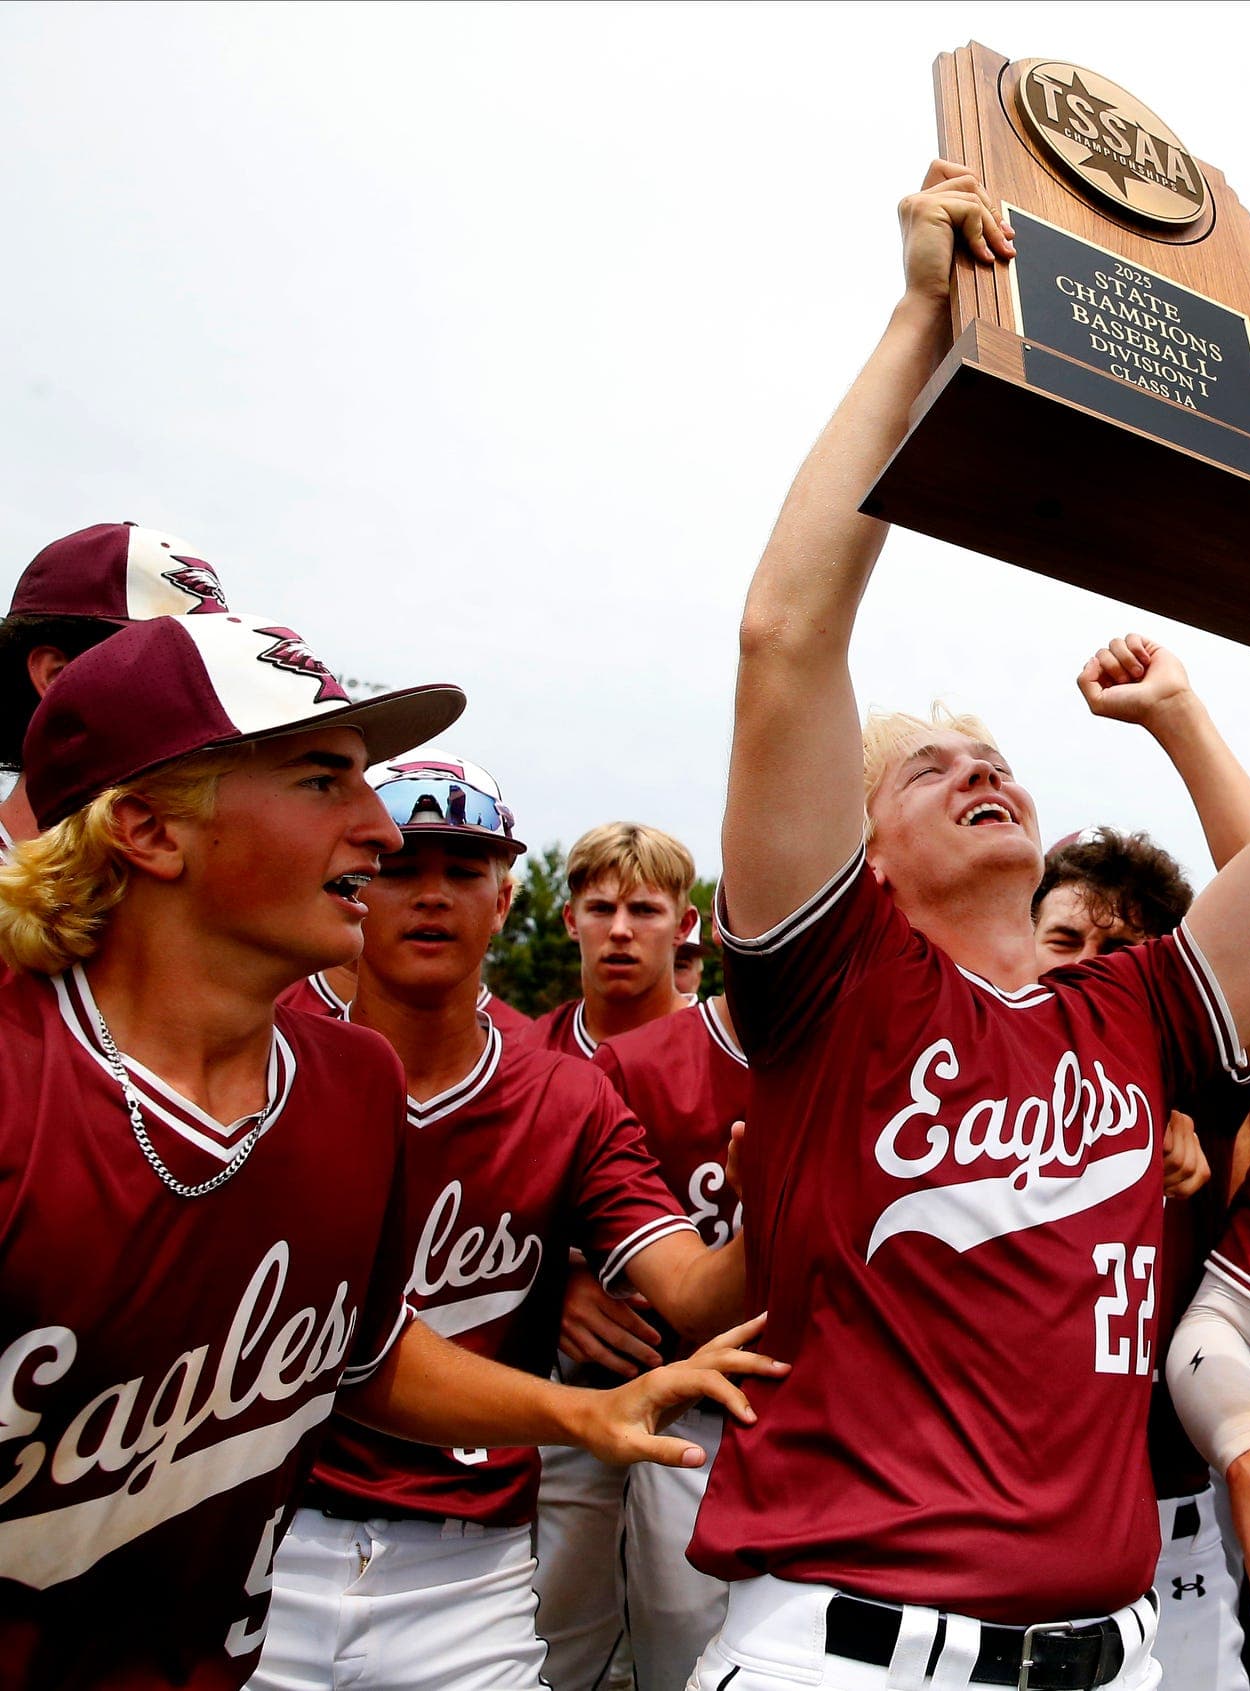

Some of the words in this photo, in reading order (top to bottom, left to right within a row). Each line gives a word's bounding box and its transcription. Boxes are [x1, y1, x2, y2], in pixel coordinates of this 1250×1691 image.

[1033, 73, 1197, 194] TSSAA
[1064, 128, 1178, 192] CHAMPIONSHIPS
[1094, 271, 1181, 323] STATE
[1114, 263, 1153, 289] 2025
[1056, 275, 1223, 362] CHAMPIONS
[1070, 302, 1217, 382] BASEBALL
[1089, 333, 1193, 391] DIVISION
[1198, 380, 1209, 397] I
[1110, 364, 1170, 398] CLASS
[1174, 389, 1197, 410] 1A
[874, 1038, 1153, 1192] Eagles
[403, 1180, 542, 1297] les
[1092, 1243, 1156, 1376] 22
[0, 1240, 357, 1504] Eagles
